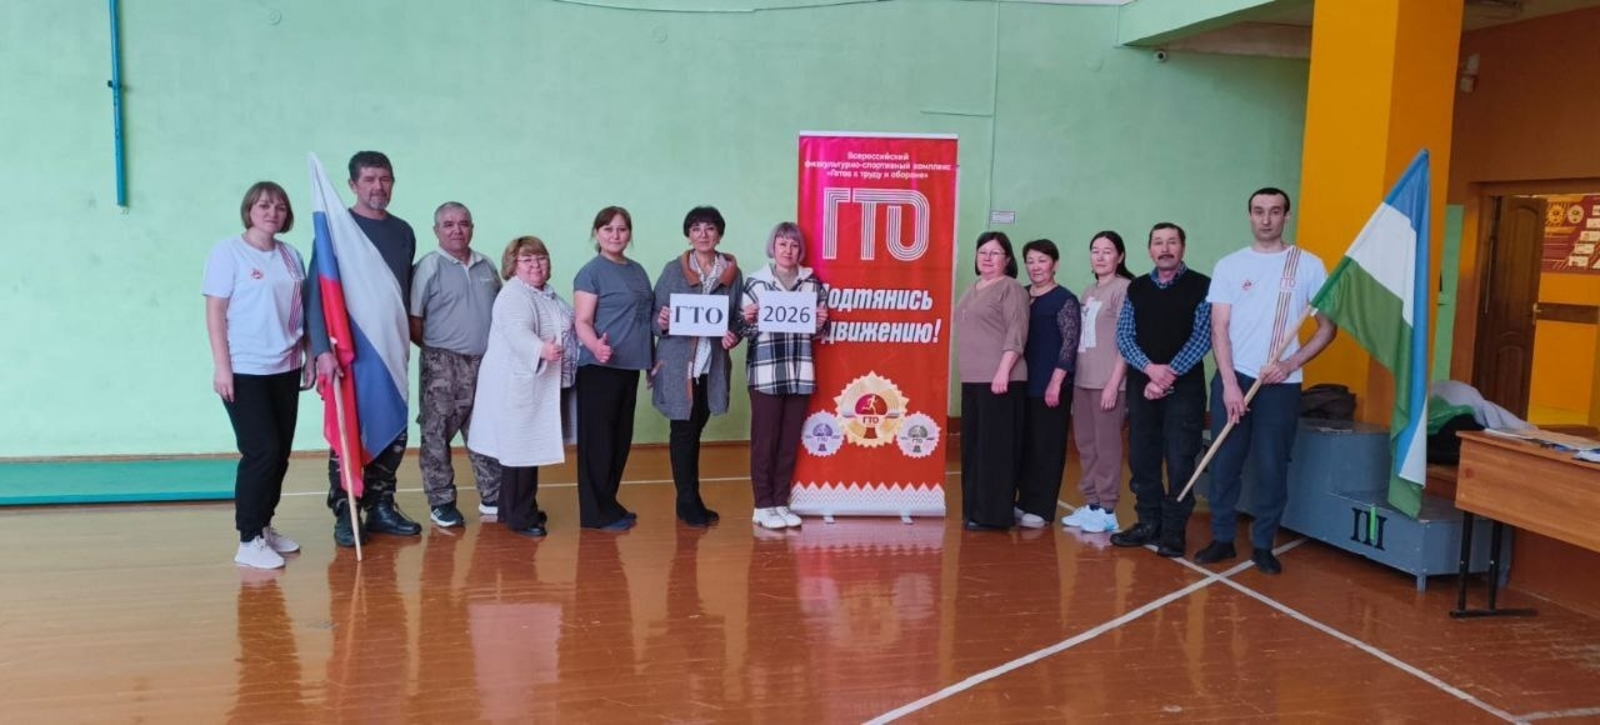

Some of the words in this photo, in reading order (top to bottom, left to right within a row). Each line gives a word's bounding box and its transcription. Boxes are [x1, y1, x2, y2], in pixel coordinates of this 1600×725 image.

[847, 152, 909, 160] Всероссийский
[860, 171, 882, 180] труду
[823, 187, 930, 261] ГТО
[823, 283, 934, 313] одтянись
[674, 305, 724, 325] ГТО
[763, 305, 811, 324] 2026
[862, 416, 880, 424] ГТО
[1350, 507, 1388, 551] III
